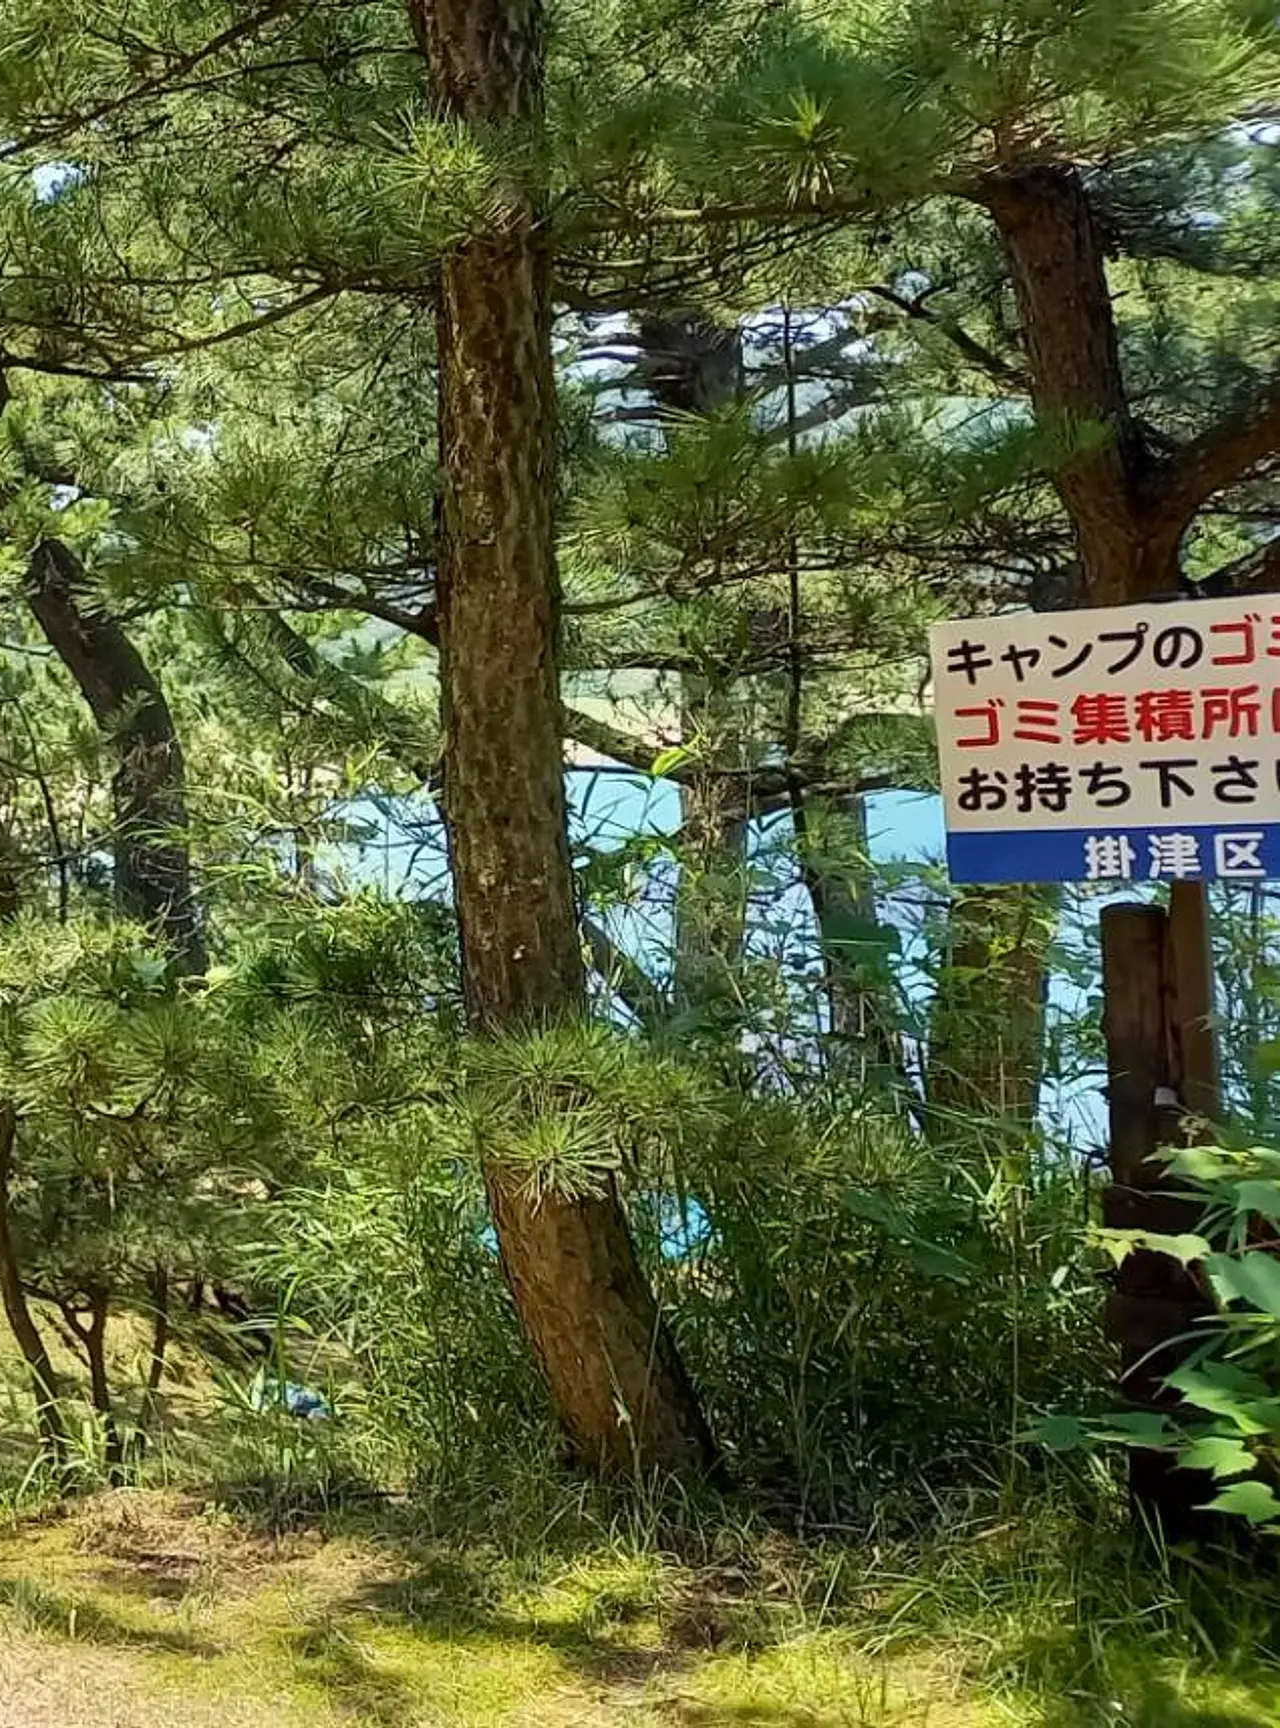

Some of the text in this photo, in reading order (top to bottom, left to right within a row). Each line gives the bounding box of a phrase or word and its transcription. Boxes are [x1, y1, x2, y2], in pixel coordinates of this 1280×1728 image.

[954, 685, 1280, 748] ゴミ集積所
[957, 755, 1280, 813] お持ち下さ
[1084, 831, 1267, 879] 掛津区
